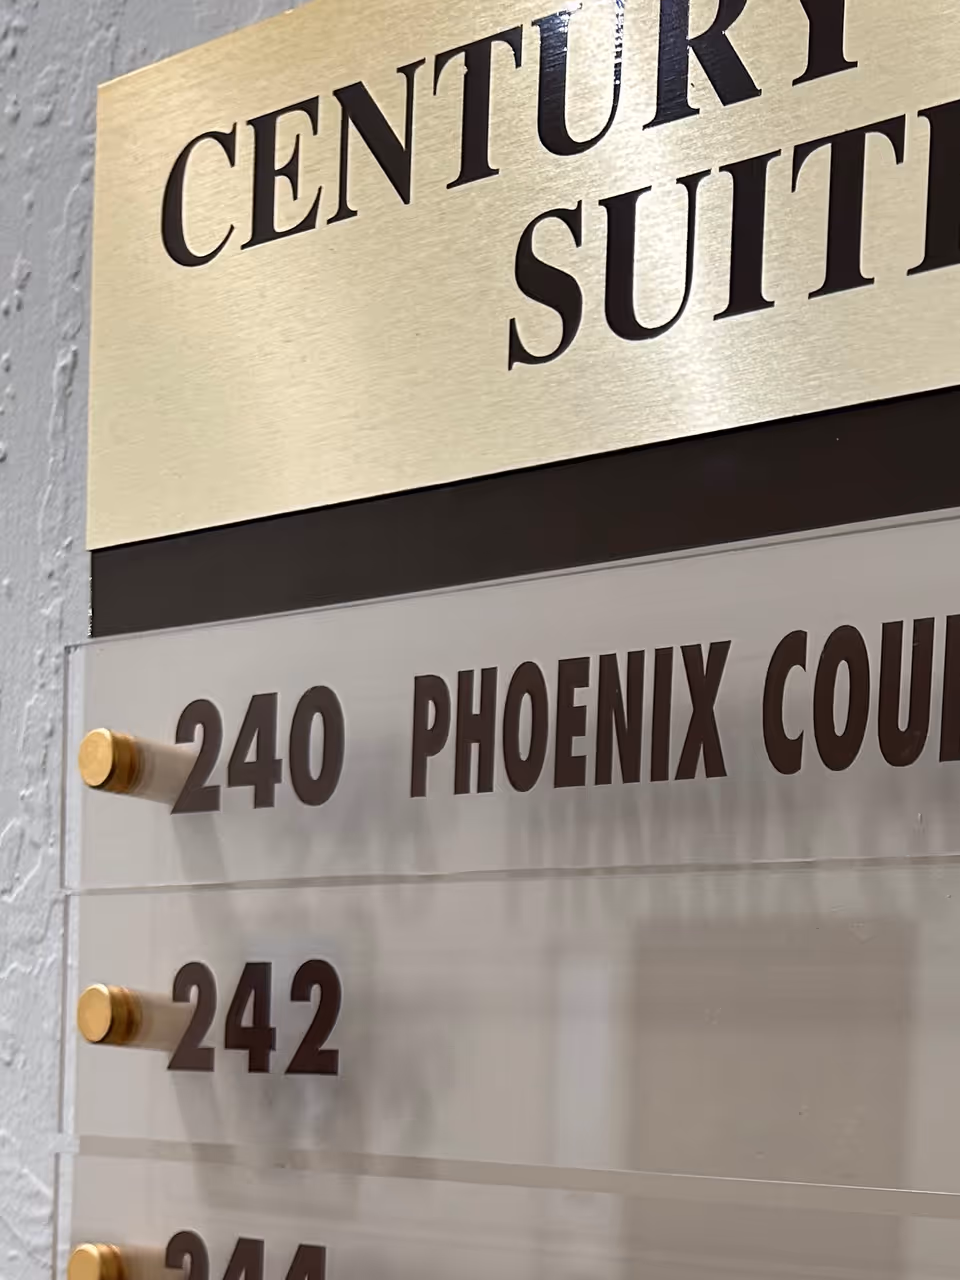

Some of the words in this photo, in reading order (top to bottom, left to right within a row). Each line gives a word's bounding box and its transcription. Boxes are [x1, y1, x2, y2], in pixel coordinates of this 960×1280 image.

[170, 684, 346, 816] 240
[409, 638, 732, 800] PHOENIX
[167, 958, 342, 1077] 242
